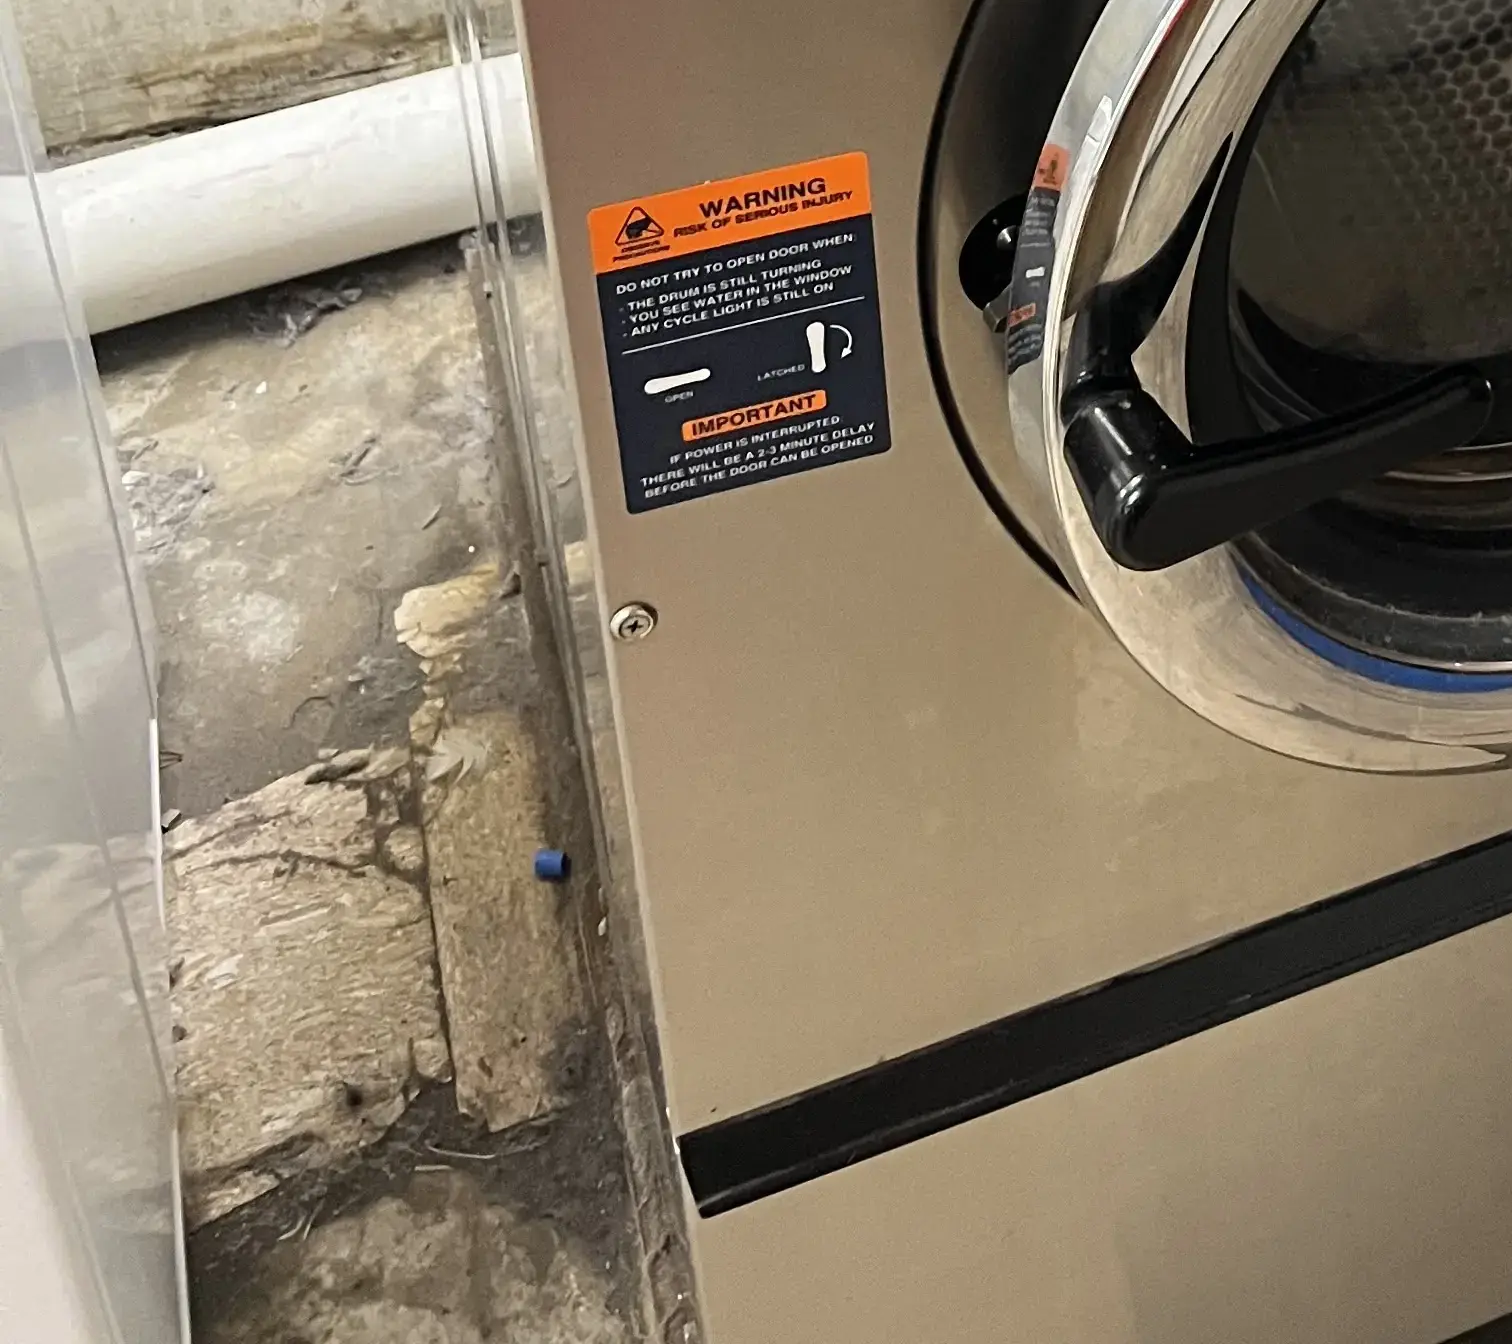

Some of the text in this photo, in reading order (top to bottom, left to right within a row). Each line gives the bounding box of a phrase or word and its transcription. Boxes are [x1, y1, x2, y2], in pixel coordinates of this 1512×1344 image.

[674, 191, 853, 237] RISK OF SERIOUS INJURY
[700, 177, 826, 218] WARNING
[617, 282, 637, 294] DO
[641, 274, 669, 288] NOT
[673, 268, 700, 281] TRY
[705, 263, 723, 274] TO
[727, 253, 765, 269] OPEN
[769, 243, 809, 260] DOOR
[628, 260, 821, 311] THE DRUM IS STILL TURNING
[629, 265, 852, 323] YOU SEE WATER IN THE WINDOW
[631, 282, 833, 336] ANY CYCLE LIGHT IS STILL ON
[692, 394, 816, 436] IMPORTANT
[640, 422, 874, 487] THERE WILL BE A 2-3 MINUTE DELAY
[645, 435, 873, 498] BEFORE THE DOOR CAN BE OPENED
[670, 454, 680, 464] IF
[685, 441, 732, 461] POWER
[736, 438, 748, 448] IS
